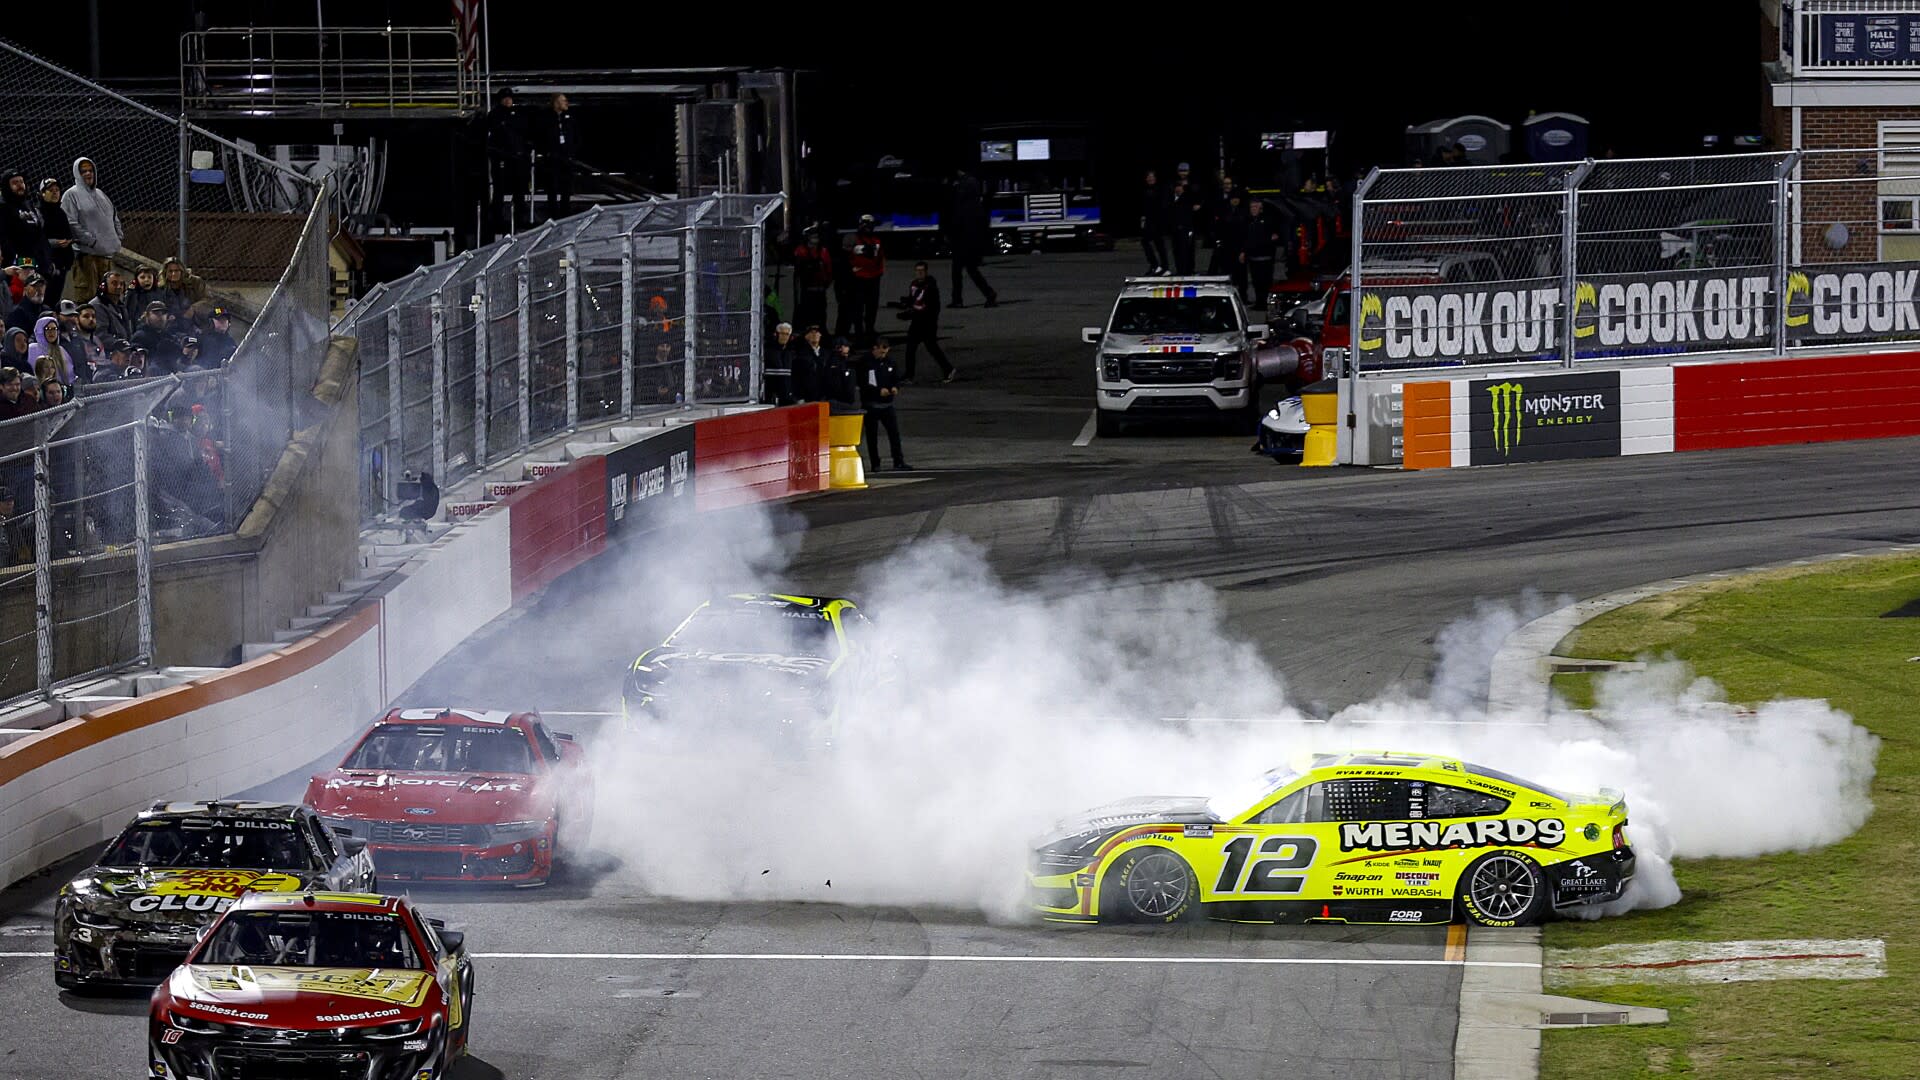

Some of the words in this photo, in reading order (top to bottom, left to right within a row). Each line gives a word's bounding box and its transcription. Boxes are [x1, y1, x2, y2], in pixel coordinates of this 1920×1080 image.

[1870, 31, 1895, 39] HALL
[1870, 41, 1895, 49] FAME
[1812, 270, 1920, 334] COOK
[1600, 280, 1700, 345] COOK
[1704, 277, 1769, 340] OUT
[1386, 292, 1488, 358] COOK
[1492, 288, 1560, 353] OUT
[1525, 392, 1605, 415] MONSTER
[1537, 414, 1593, 426] ENERGY
[782, 611, 824, 620] HALEY
[1475, 782, 1517, 796] ADVANCE
[235, 821, 292, 830] DILLON
[1340, 819, 1566, 851] MENARDS
[1213, 835, 1318, 894] 12
[1503, 850, 1532, 865] EAGLE
[1120, 857, 1136, 887] EAGLE
[1334, 872, 1383, 882] Snap-on
[1395, 872, 1440, 880] DISCOUNT
[1560, 878, 1583, 886] GREAT
[1585, 878, 1607, 886] LAKES
[1346, 887, 1384, 896] WÜRTH
[1391, 888, 1442, 896] WABASH
[324, 912, 339, 920] T.
[343, 913, 393, 922] DILLON
[1390, 910, 1423, 918] FORD
[78, 928, 92, 943] 3
[189, 1001, 269, 1020] seabest.com
[316, 1007, 400, 1022] seabest.com
[162, 1029, 184, 1044] 10
